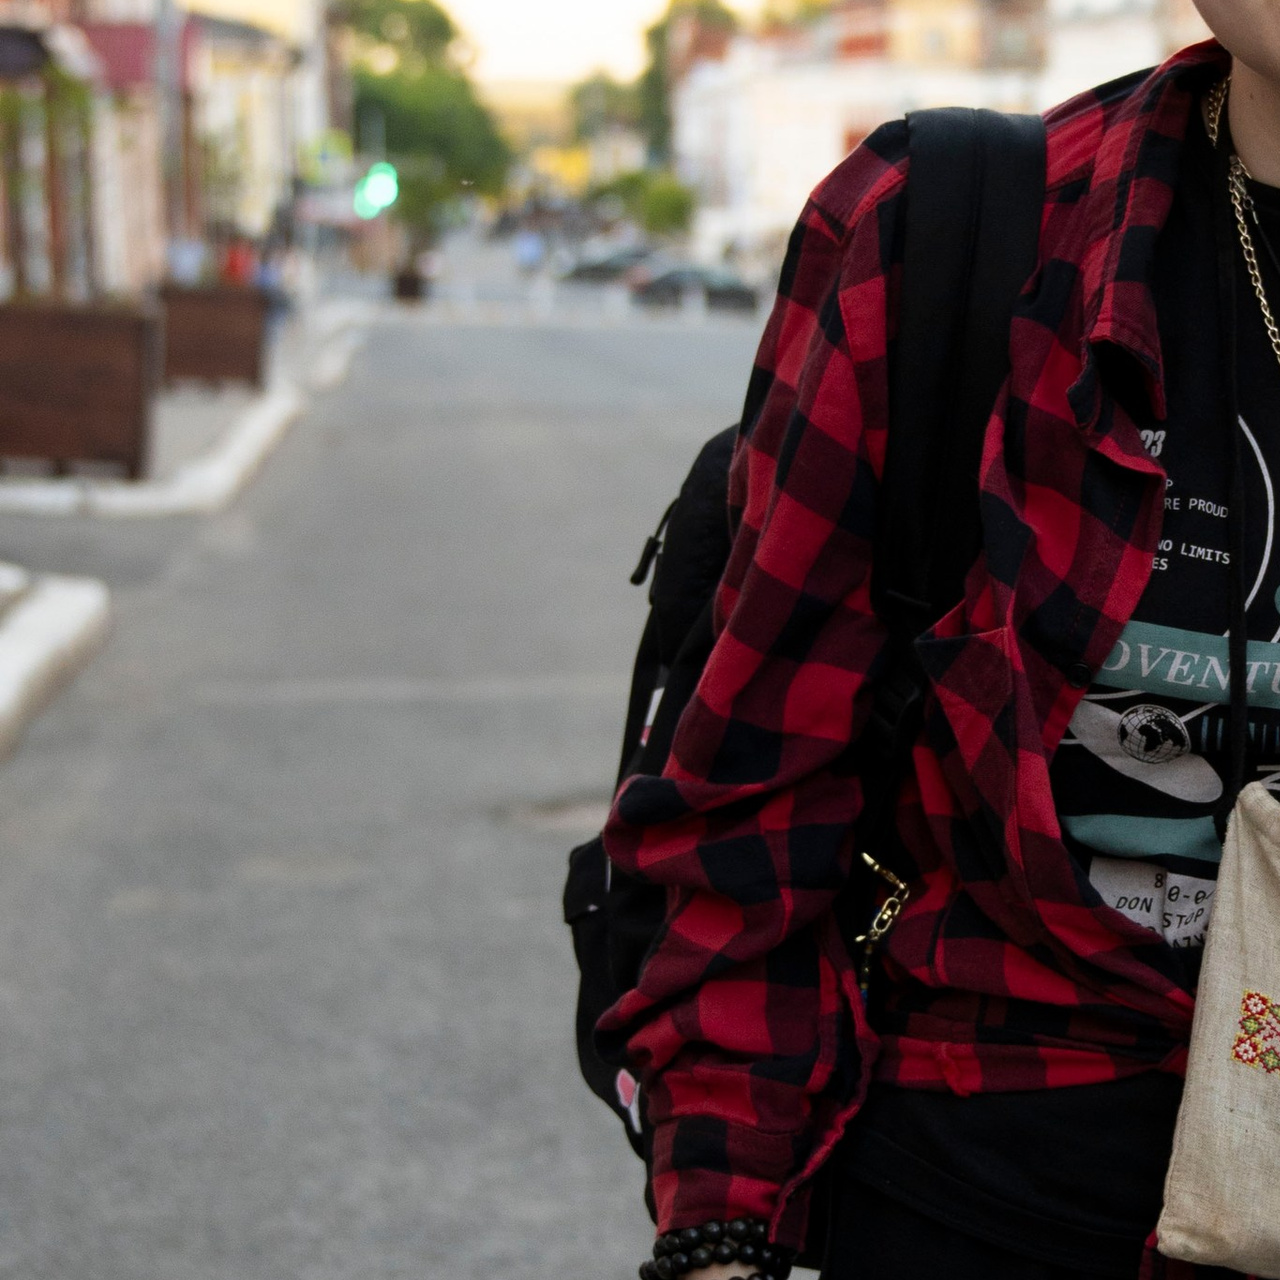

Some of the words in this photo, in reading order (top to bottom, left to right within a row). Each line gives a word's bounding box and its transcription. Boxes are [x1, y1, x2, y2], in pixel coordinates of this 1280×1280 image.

[1188, 497, 1229, 518] PROUD
[1180, 542, 1230, 565] LIMITS
[1162, 907, 1205, 929] STOP
